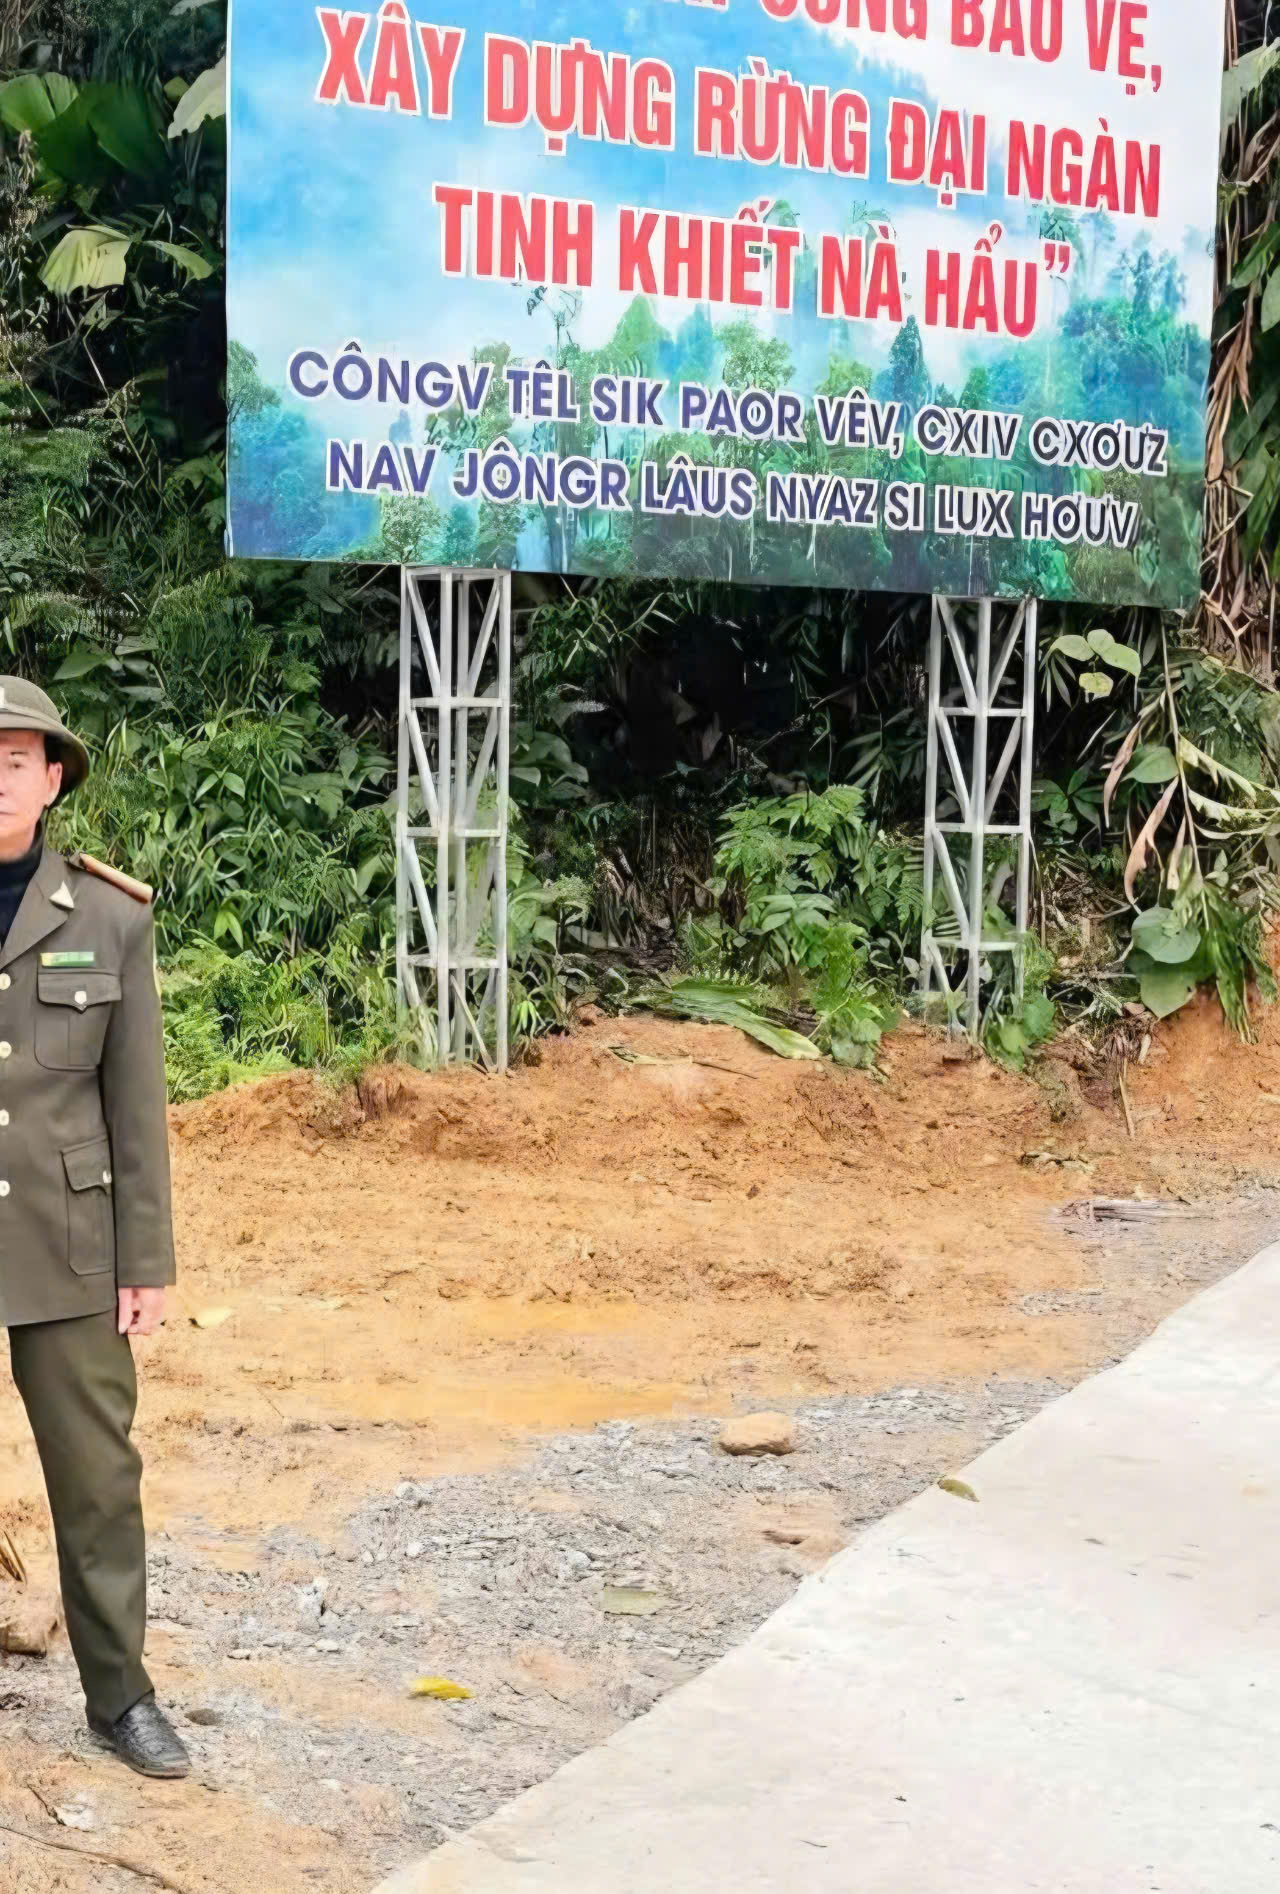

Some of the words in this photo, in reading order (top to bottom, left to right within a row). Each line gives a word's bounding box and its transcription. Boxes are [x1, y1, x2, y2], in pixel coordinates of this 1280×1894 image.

[320, 2, 464, 115] XÂY
[488, 38, 672, 151] DỰNG
[698, 57, 867, 174] RỪNG
[889, 101, 986, 205] ĐẠI
[1008, 118, 1160, 217] NGÀN
[435, 186, 592, 286] TINH
[620, 200, 800, 310] KHIẾT
[821, 225, 902, 322] NÀ
[289, 342, 489, 412] CÔNGV
[506, 360, 578, 417] TÊL
[592, 379, 663, 427] SIK
[681, 385, 802, 438] PAOR
[819, 390, 900, 456] VÊV,
[919, 407, 1018, 456] CXIV
[329, 440, 437, 494] NAV
[453, 440, 626, 508] JÔNGR
[646, 456, 754, 516] LÂUS
[770, 478, 876, 523] NYAZ
[888, 484, 922, 529] SI
[939, 489, 1010, 534] LUX
